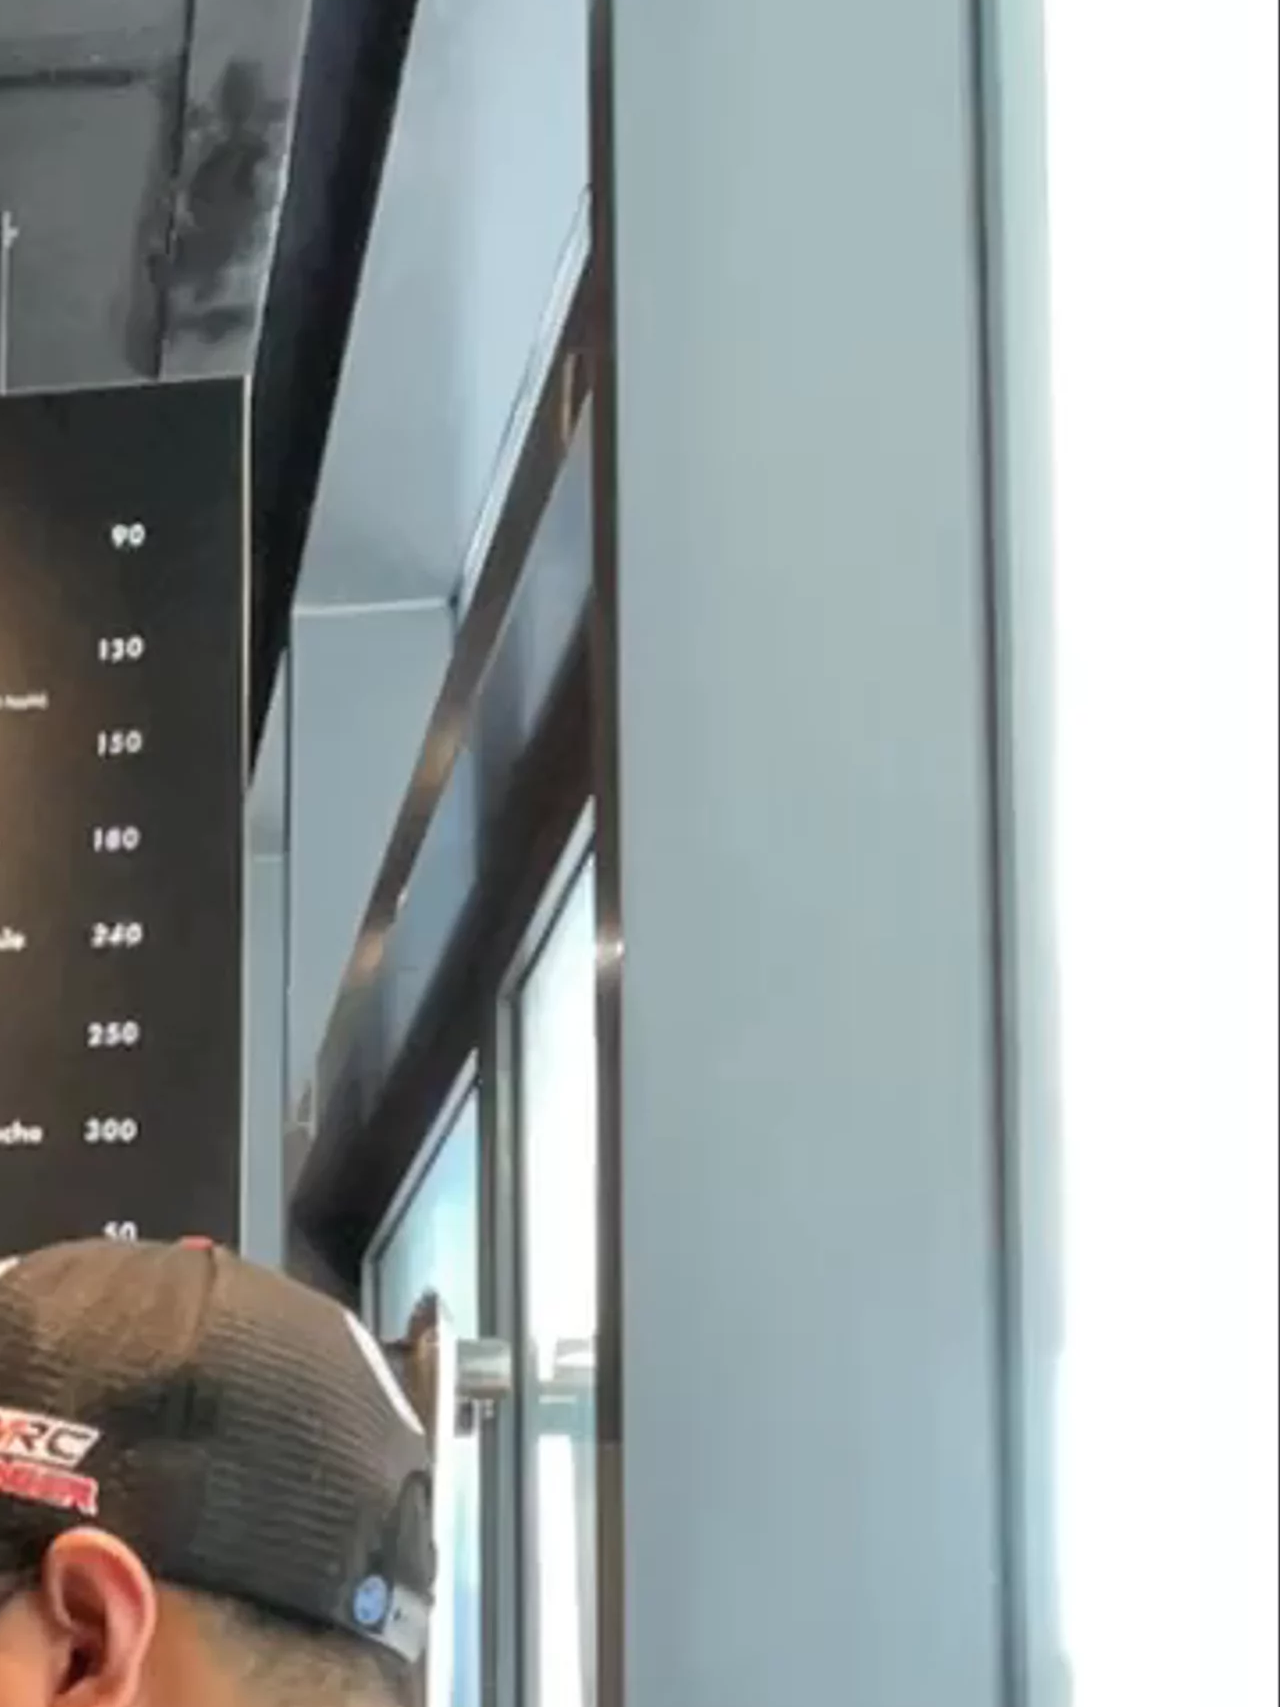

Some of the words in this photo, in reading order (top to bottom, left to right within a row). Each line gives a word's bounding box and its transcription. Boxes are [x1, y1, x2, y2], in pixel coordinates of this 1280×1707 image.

[110, 523, 146, 548] 90
[99, 635, 145, 662] 130
[97, 730, 142, 757] 150
[87, 1021, 140, 1049] 250
[84, 1118, 138, 1144] 300
